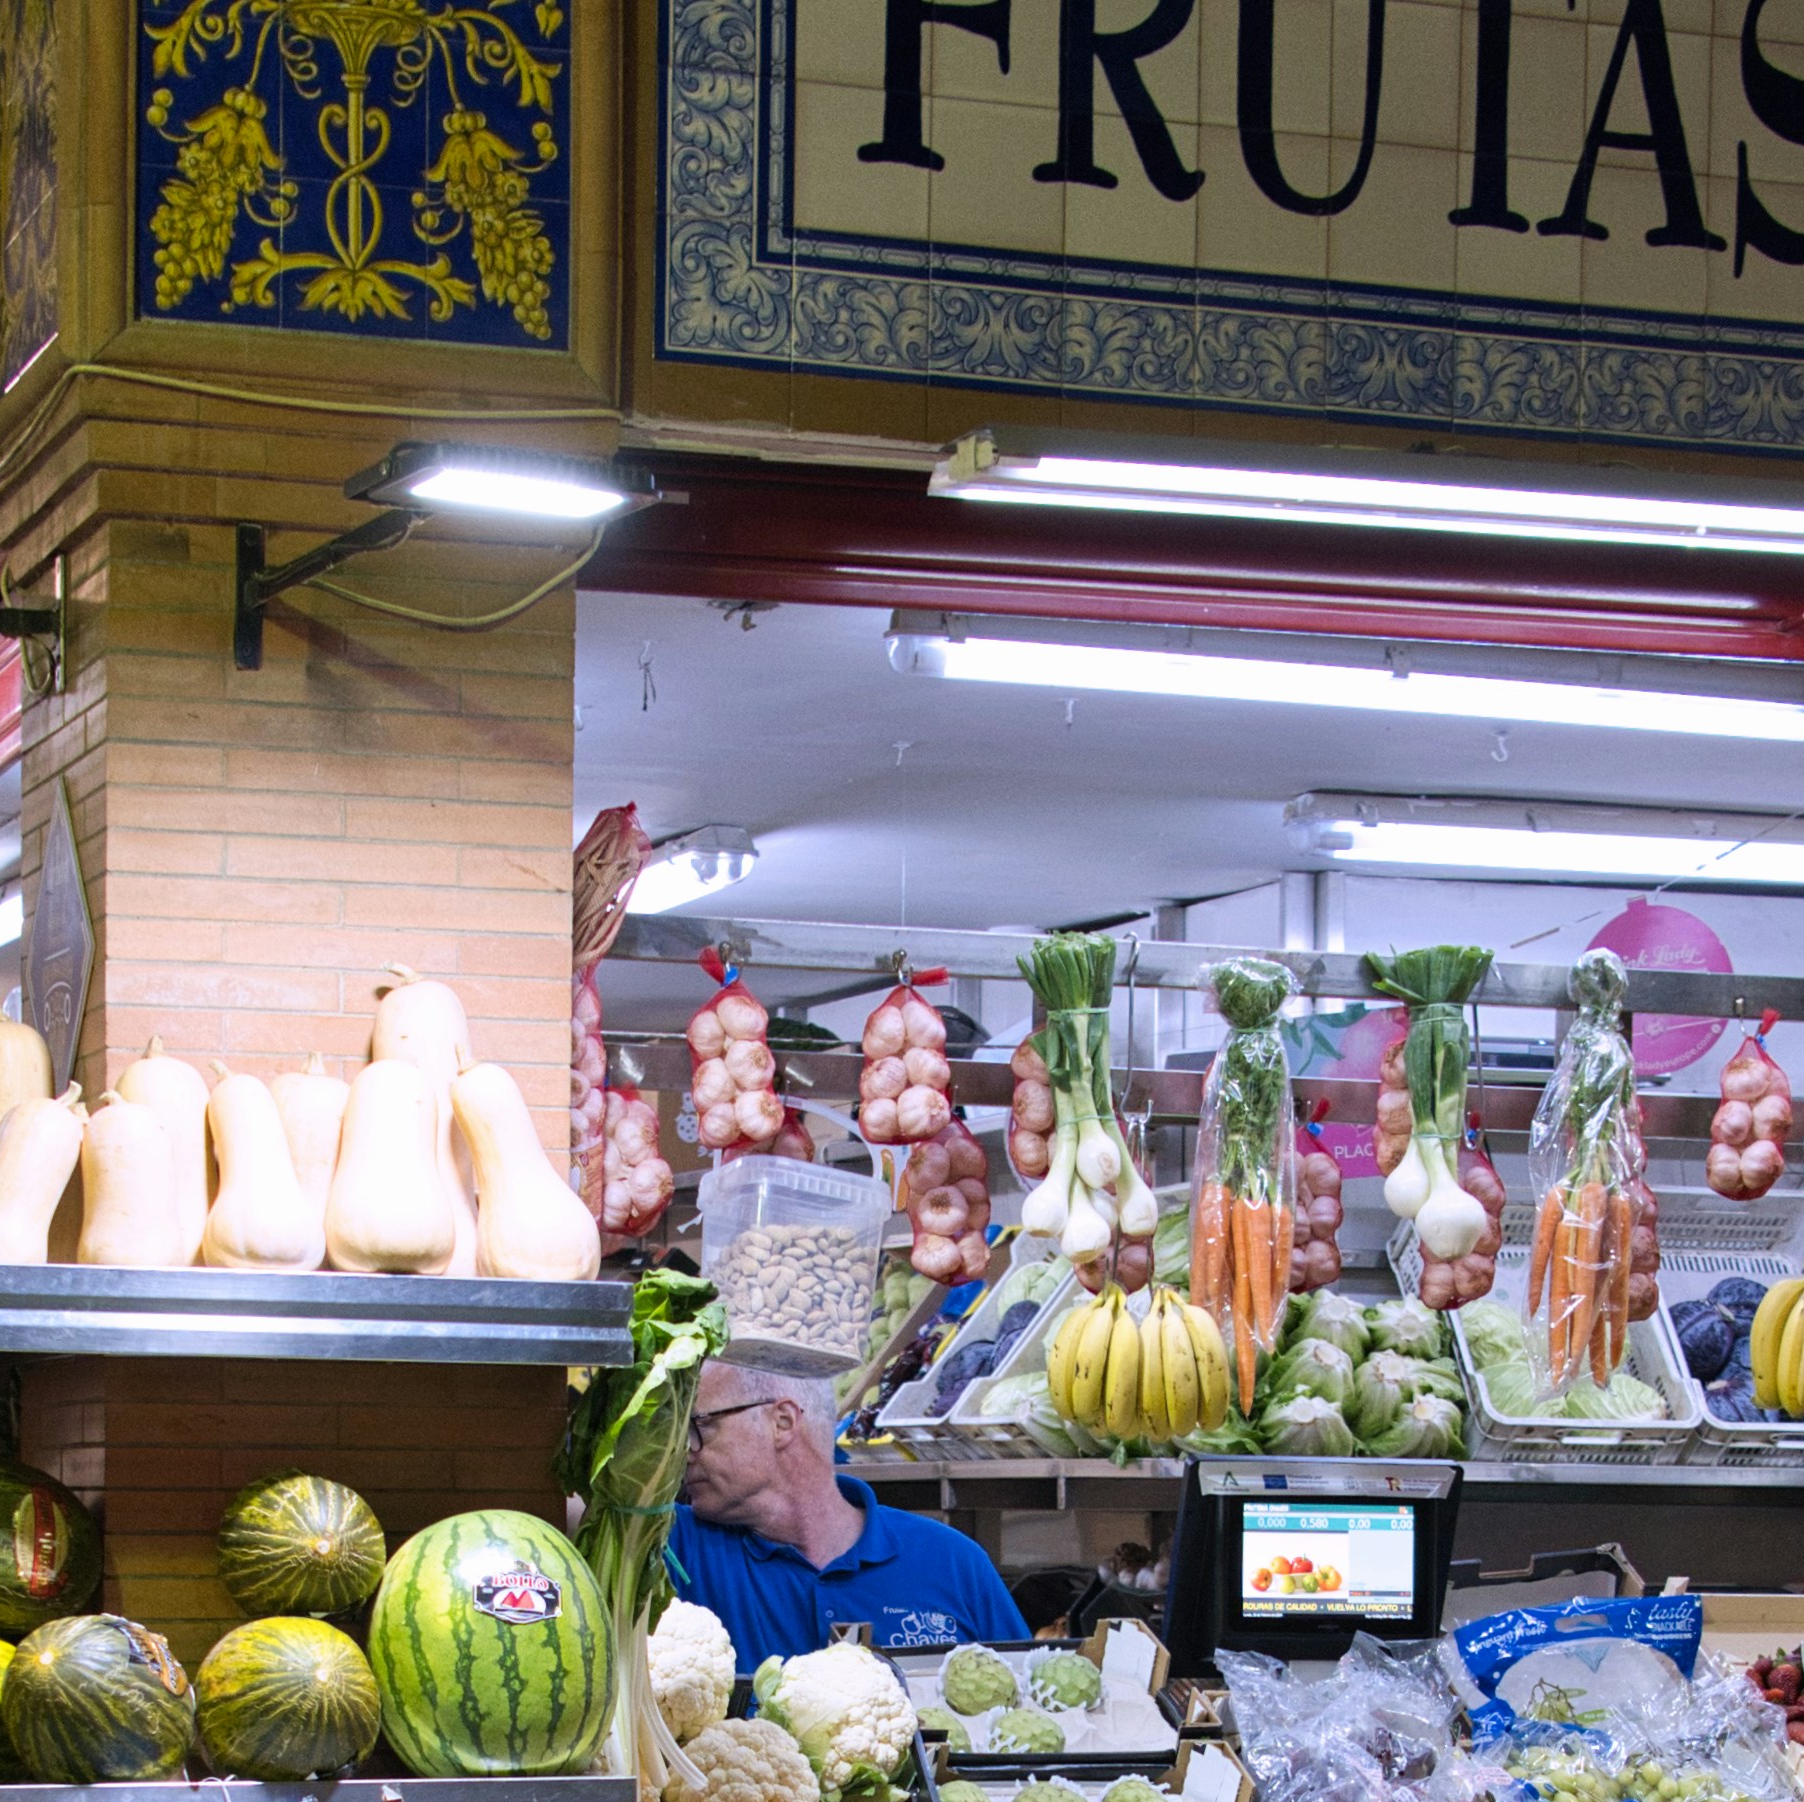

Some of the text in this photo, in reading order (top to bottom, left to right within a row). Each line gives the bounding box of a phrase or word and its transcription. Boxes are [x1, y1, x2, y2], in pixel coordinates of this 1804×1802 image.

[1286, 1602, 1318, 1612] CALIDAD
[1326, 1602, 1355, 1613] VUELVA
[1356, 1603, 1367, 1613] LO
[1367, 1603, 1399, 1613] PRONTO
[1648, 1602, 1696, 1621] tasty
[889, 1632, 957, 1647] Chaves
